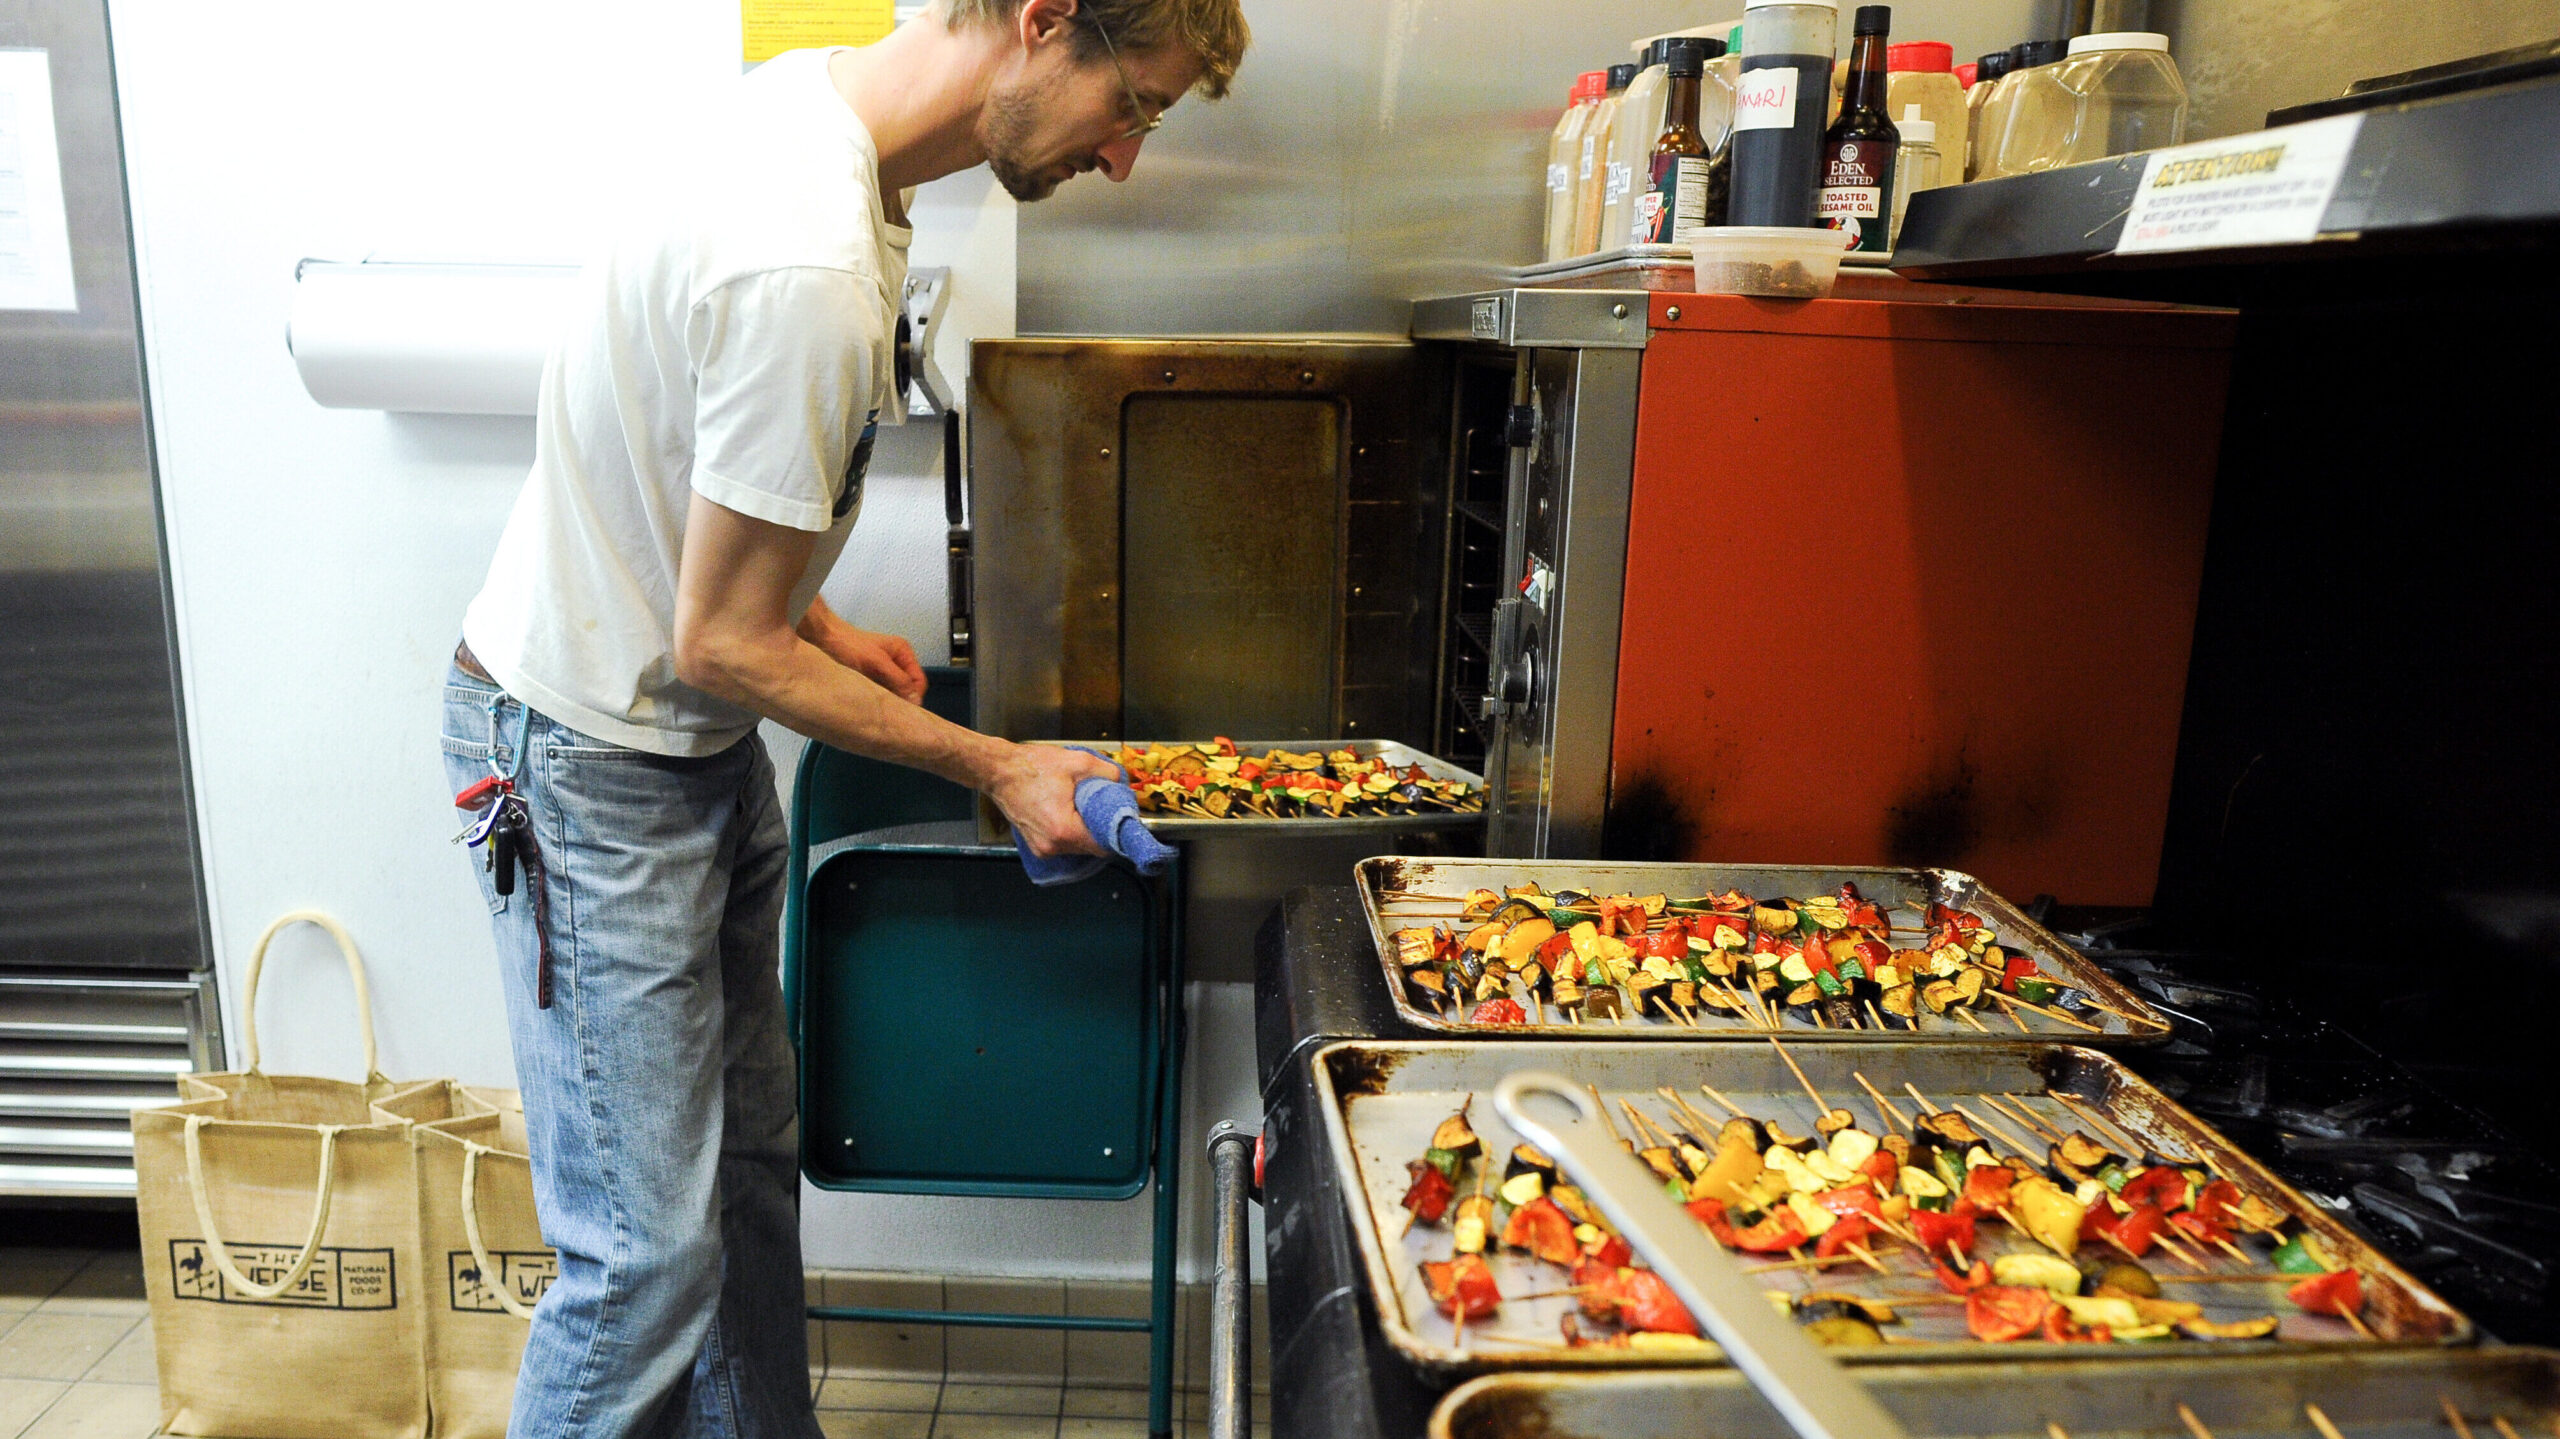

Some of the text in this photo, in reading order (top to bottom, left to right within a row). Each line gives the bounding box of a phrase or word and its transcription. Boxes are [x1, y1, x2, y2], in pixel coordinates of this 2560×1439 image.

[1830, 160, 1866, 176] EDEN
[1824, 176, 1874, 186] SELECTED
[1826, 193, 1869, 202] TOASTED
[1821, 203, 1874, 212] SESAME OIL
[261, 1253, 300, 1265] THE
[249, 1266, 328, 1292] EDE
